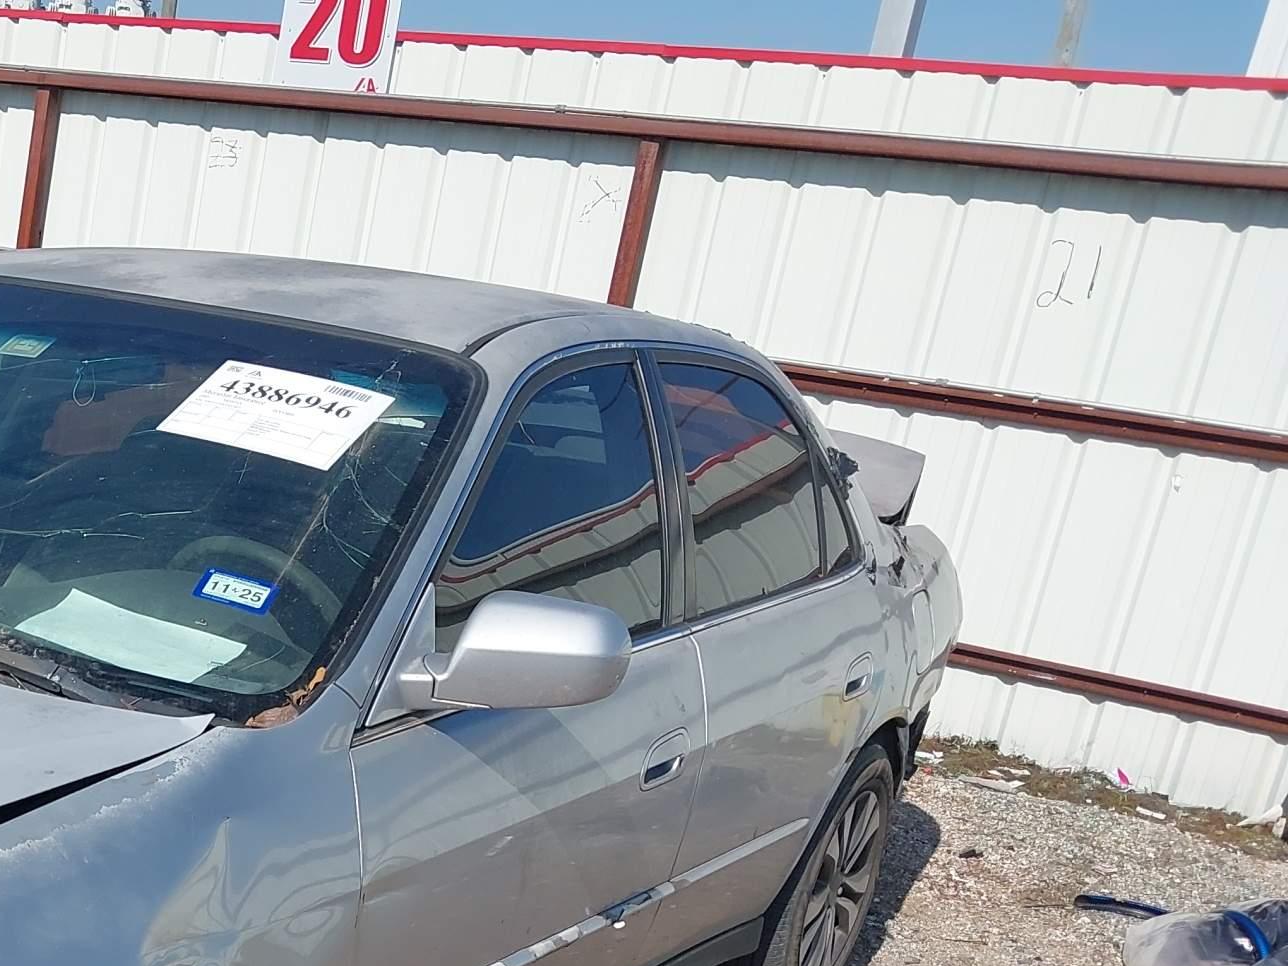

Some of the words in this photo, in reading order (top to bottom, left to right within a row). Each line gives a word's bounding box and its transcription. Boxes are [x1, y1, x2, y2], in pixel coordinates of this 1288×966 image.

[289, 0, 389, 66] 20
[1036, 239, 1102, 308] 21
[220, 379, 358, 419] 43886946
